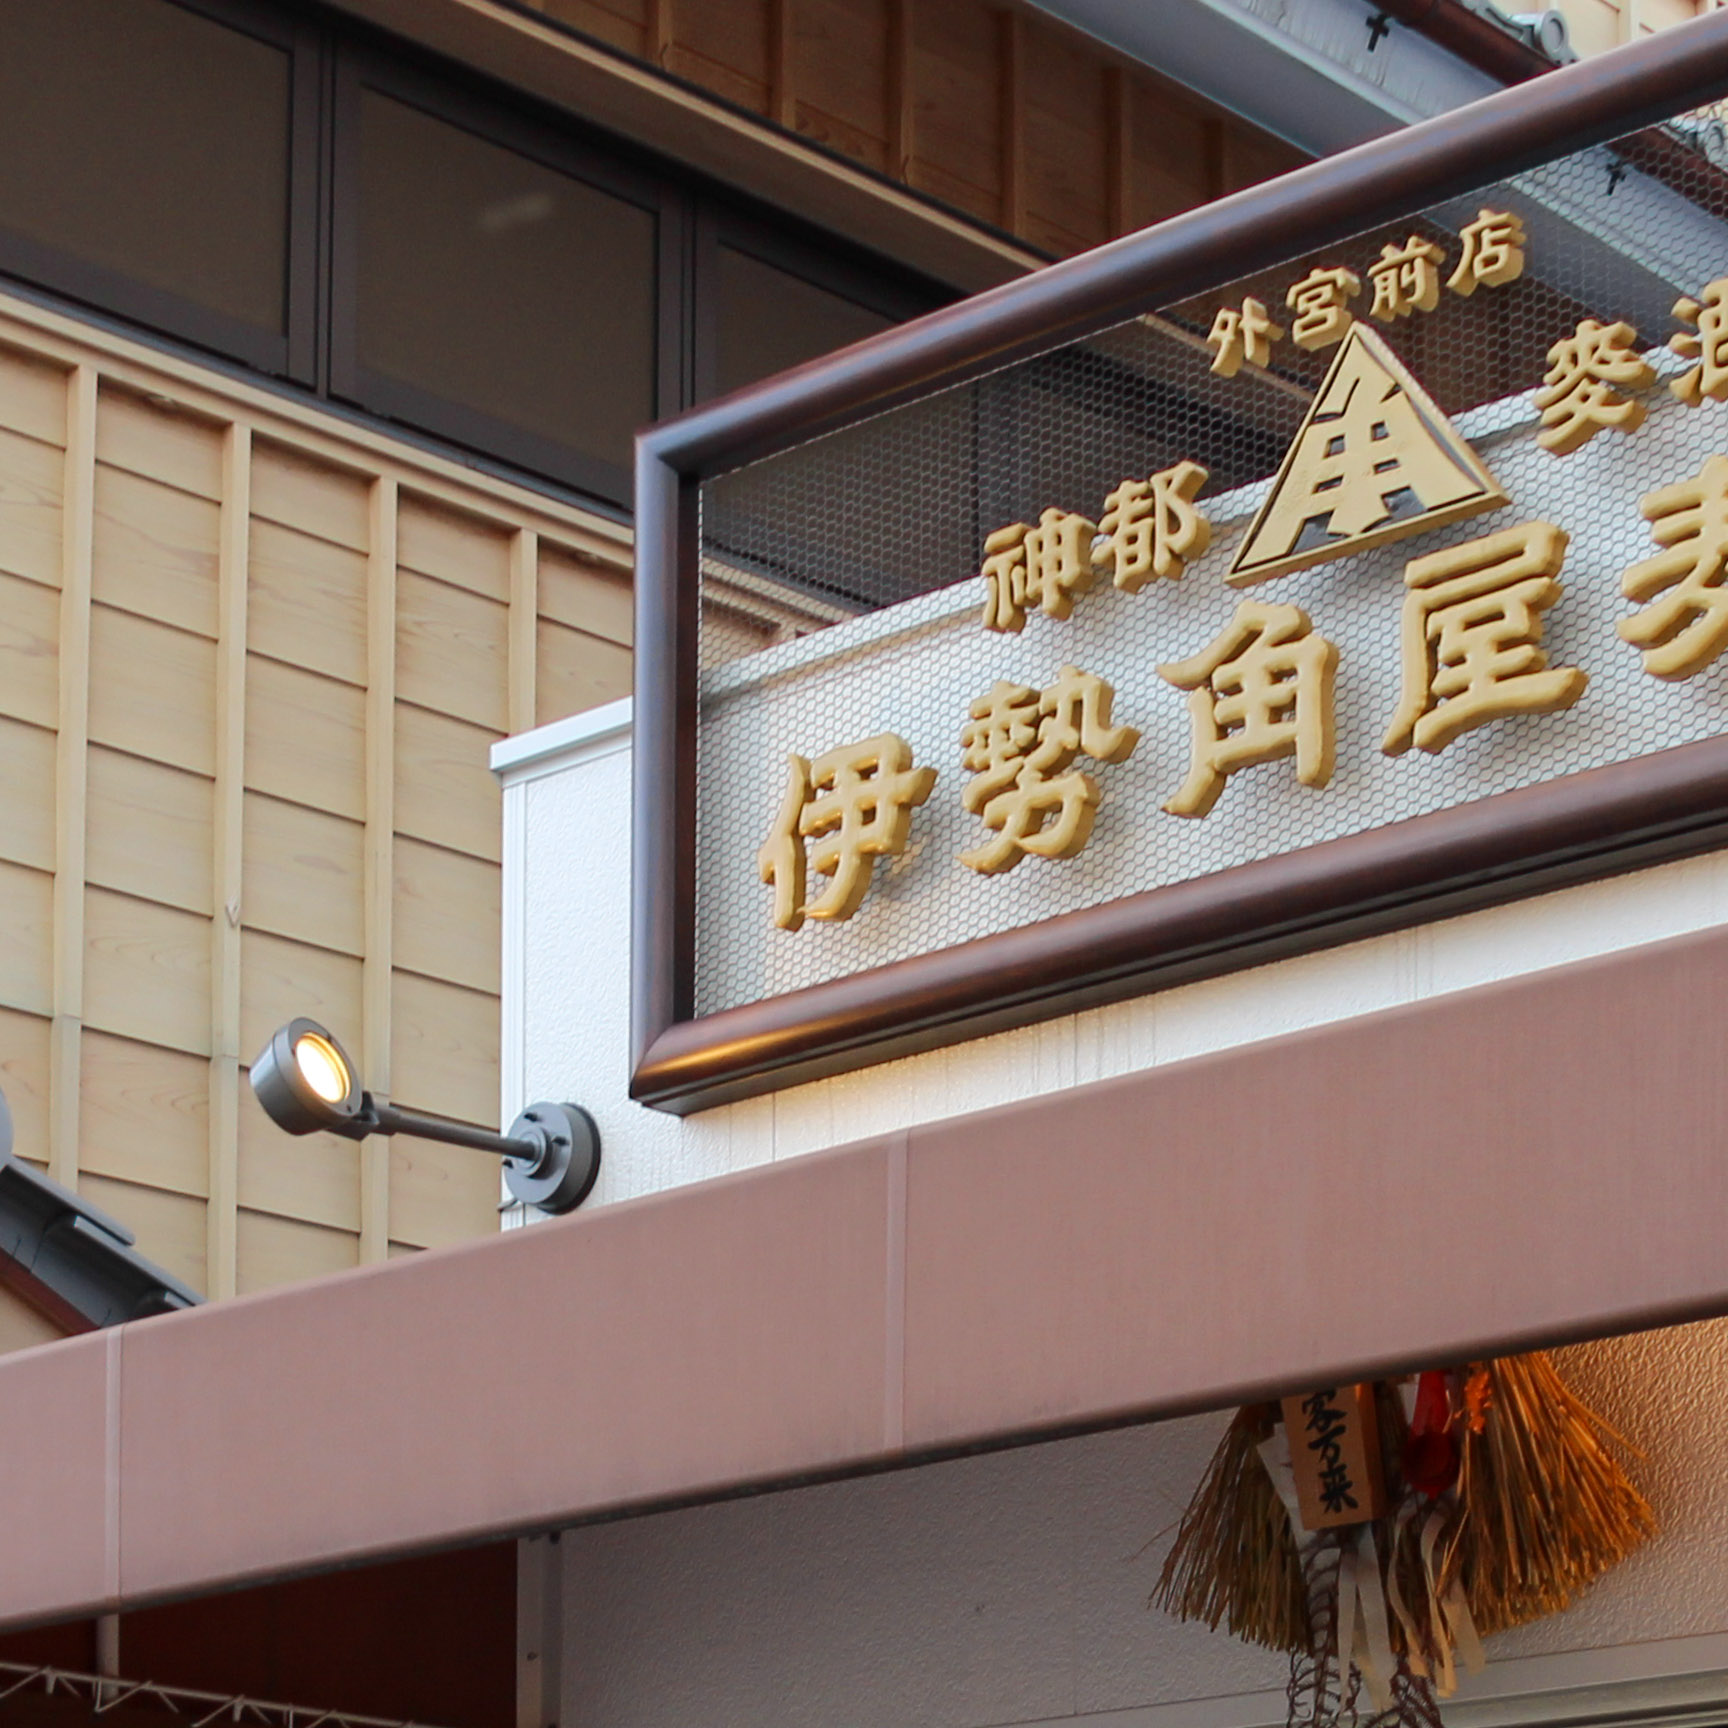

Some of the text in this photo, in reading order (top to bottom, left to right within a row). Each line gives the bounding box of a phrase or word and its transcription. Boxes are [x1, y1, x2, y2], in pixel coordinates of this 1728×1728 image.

[1208, 206, 1525, 378] 外宮前店
[981, 459, 1210, 635] 神都
